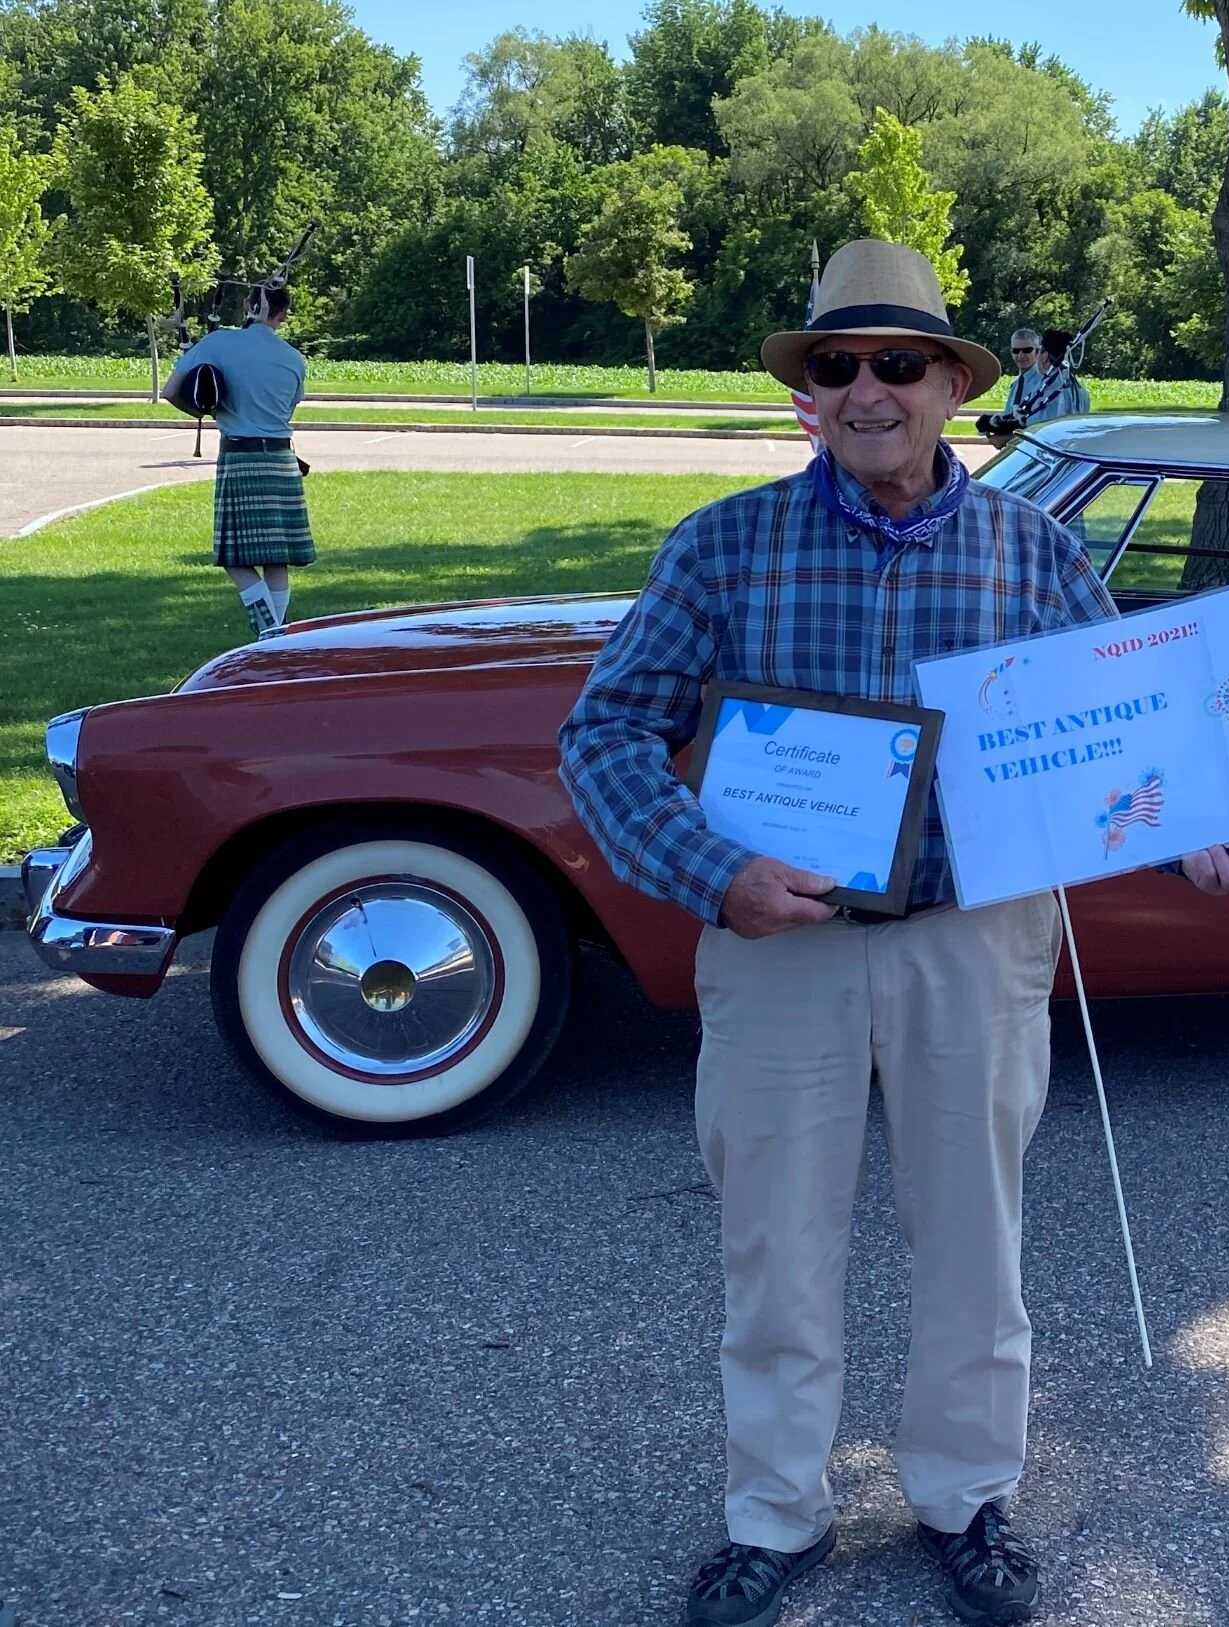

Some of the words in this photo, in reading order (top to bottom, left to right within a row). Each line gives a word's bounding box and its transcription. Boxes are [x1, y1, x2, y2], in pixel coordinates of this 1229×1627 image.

[1092, 638, 1143, 661] NQID
[1147, 622, 1199, 648] 2021!!
[976, 720, 1046, 751] BEST
[1052, 692, 1168, 736] ANTIQUE
[764, 740, 841, 765] Certificate
[983, 737, 1124, 784] VEHICLE!!!
[774, 764, 788, 774] OF
[789, 766, 821, 779] AWARD
[722, 787, 756, 801] BEST
[755, 791, 808, 809] ANTIQUE
[810, 800, 860, 817] VEHICLE
